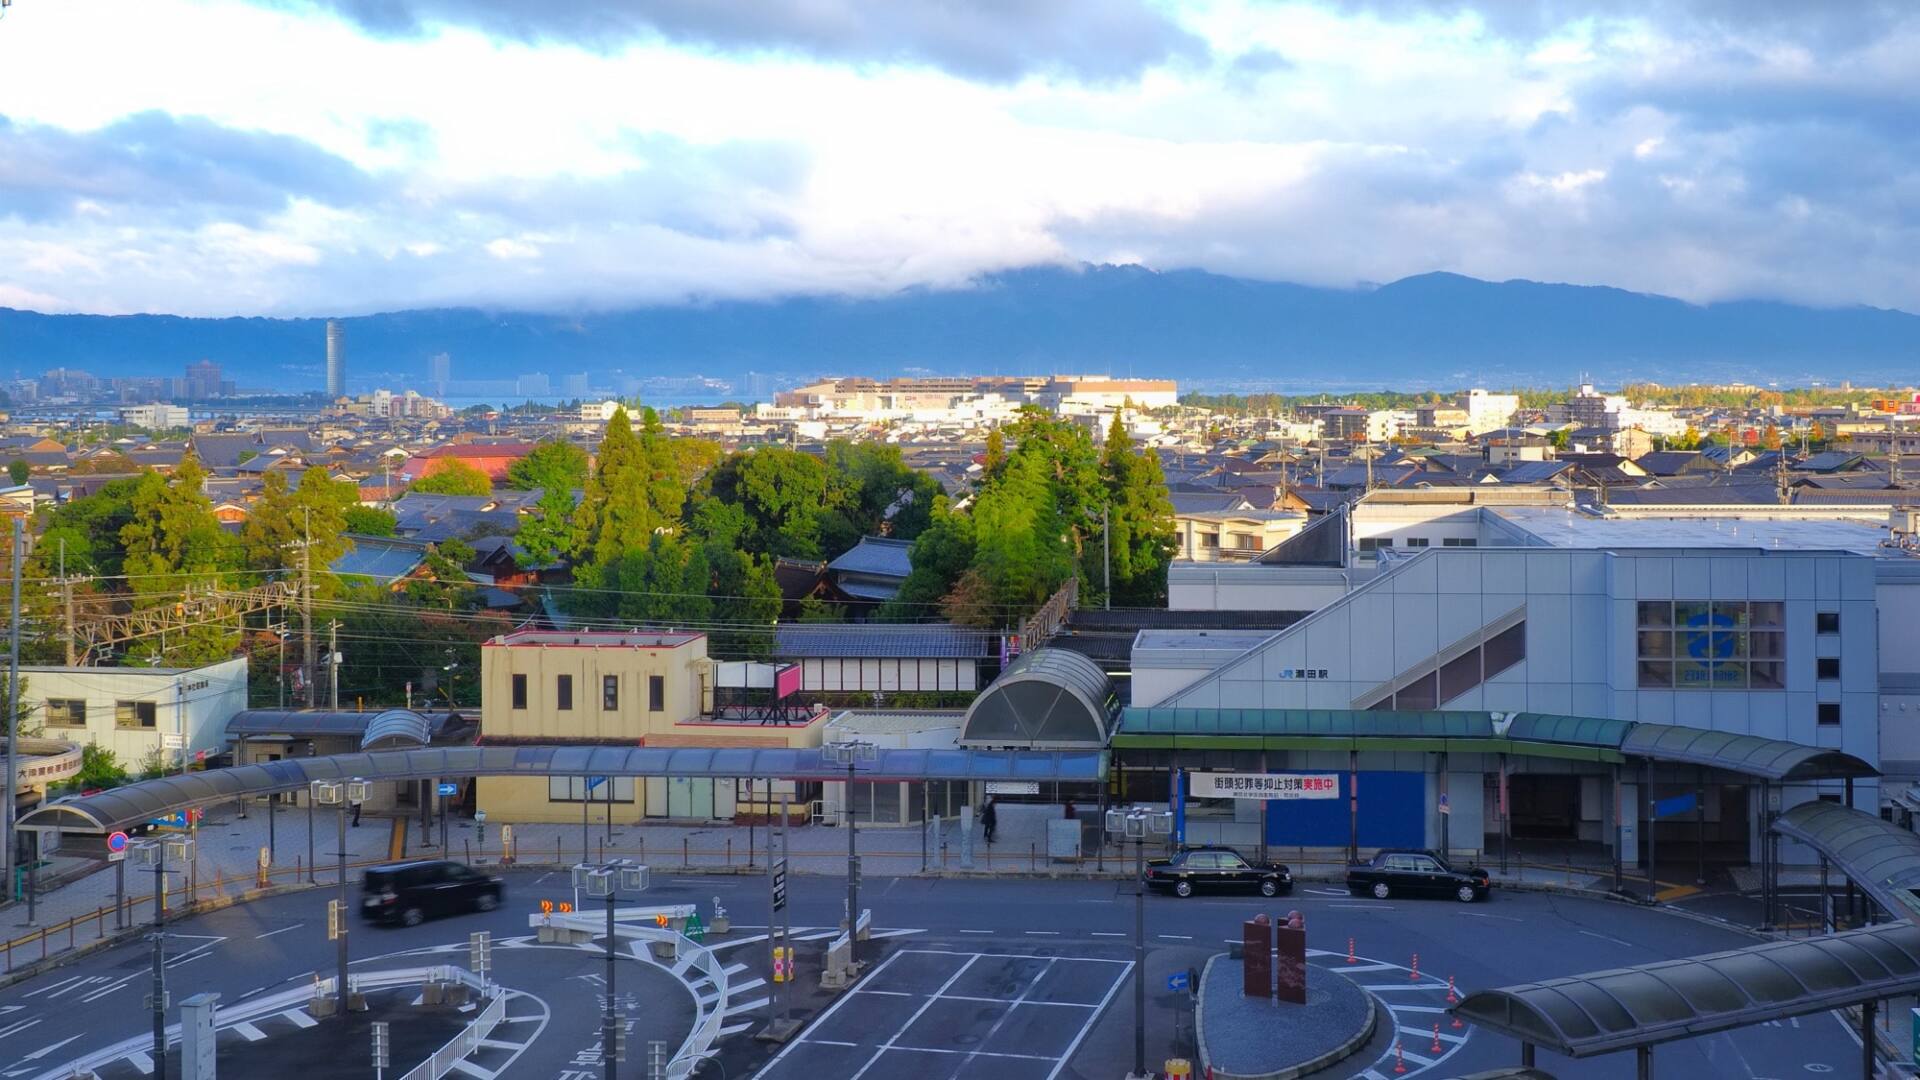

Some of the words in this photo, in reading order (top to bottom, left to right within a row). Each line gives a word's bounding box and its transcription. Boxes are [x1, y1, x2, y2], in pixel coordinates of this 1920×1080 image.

[1279, 669, 1294, 679] JR
[1295, 669, 1329, 679] 瀬田駅
[1214, 776, 1333, 791] 街頭犯罪等抑止対策実施中
